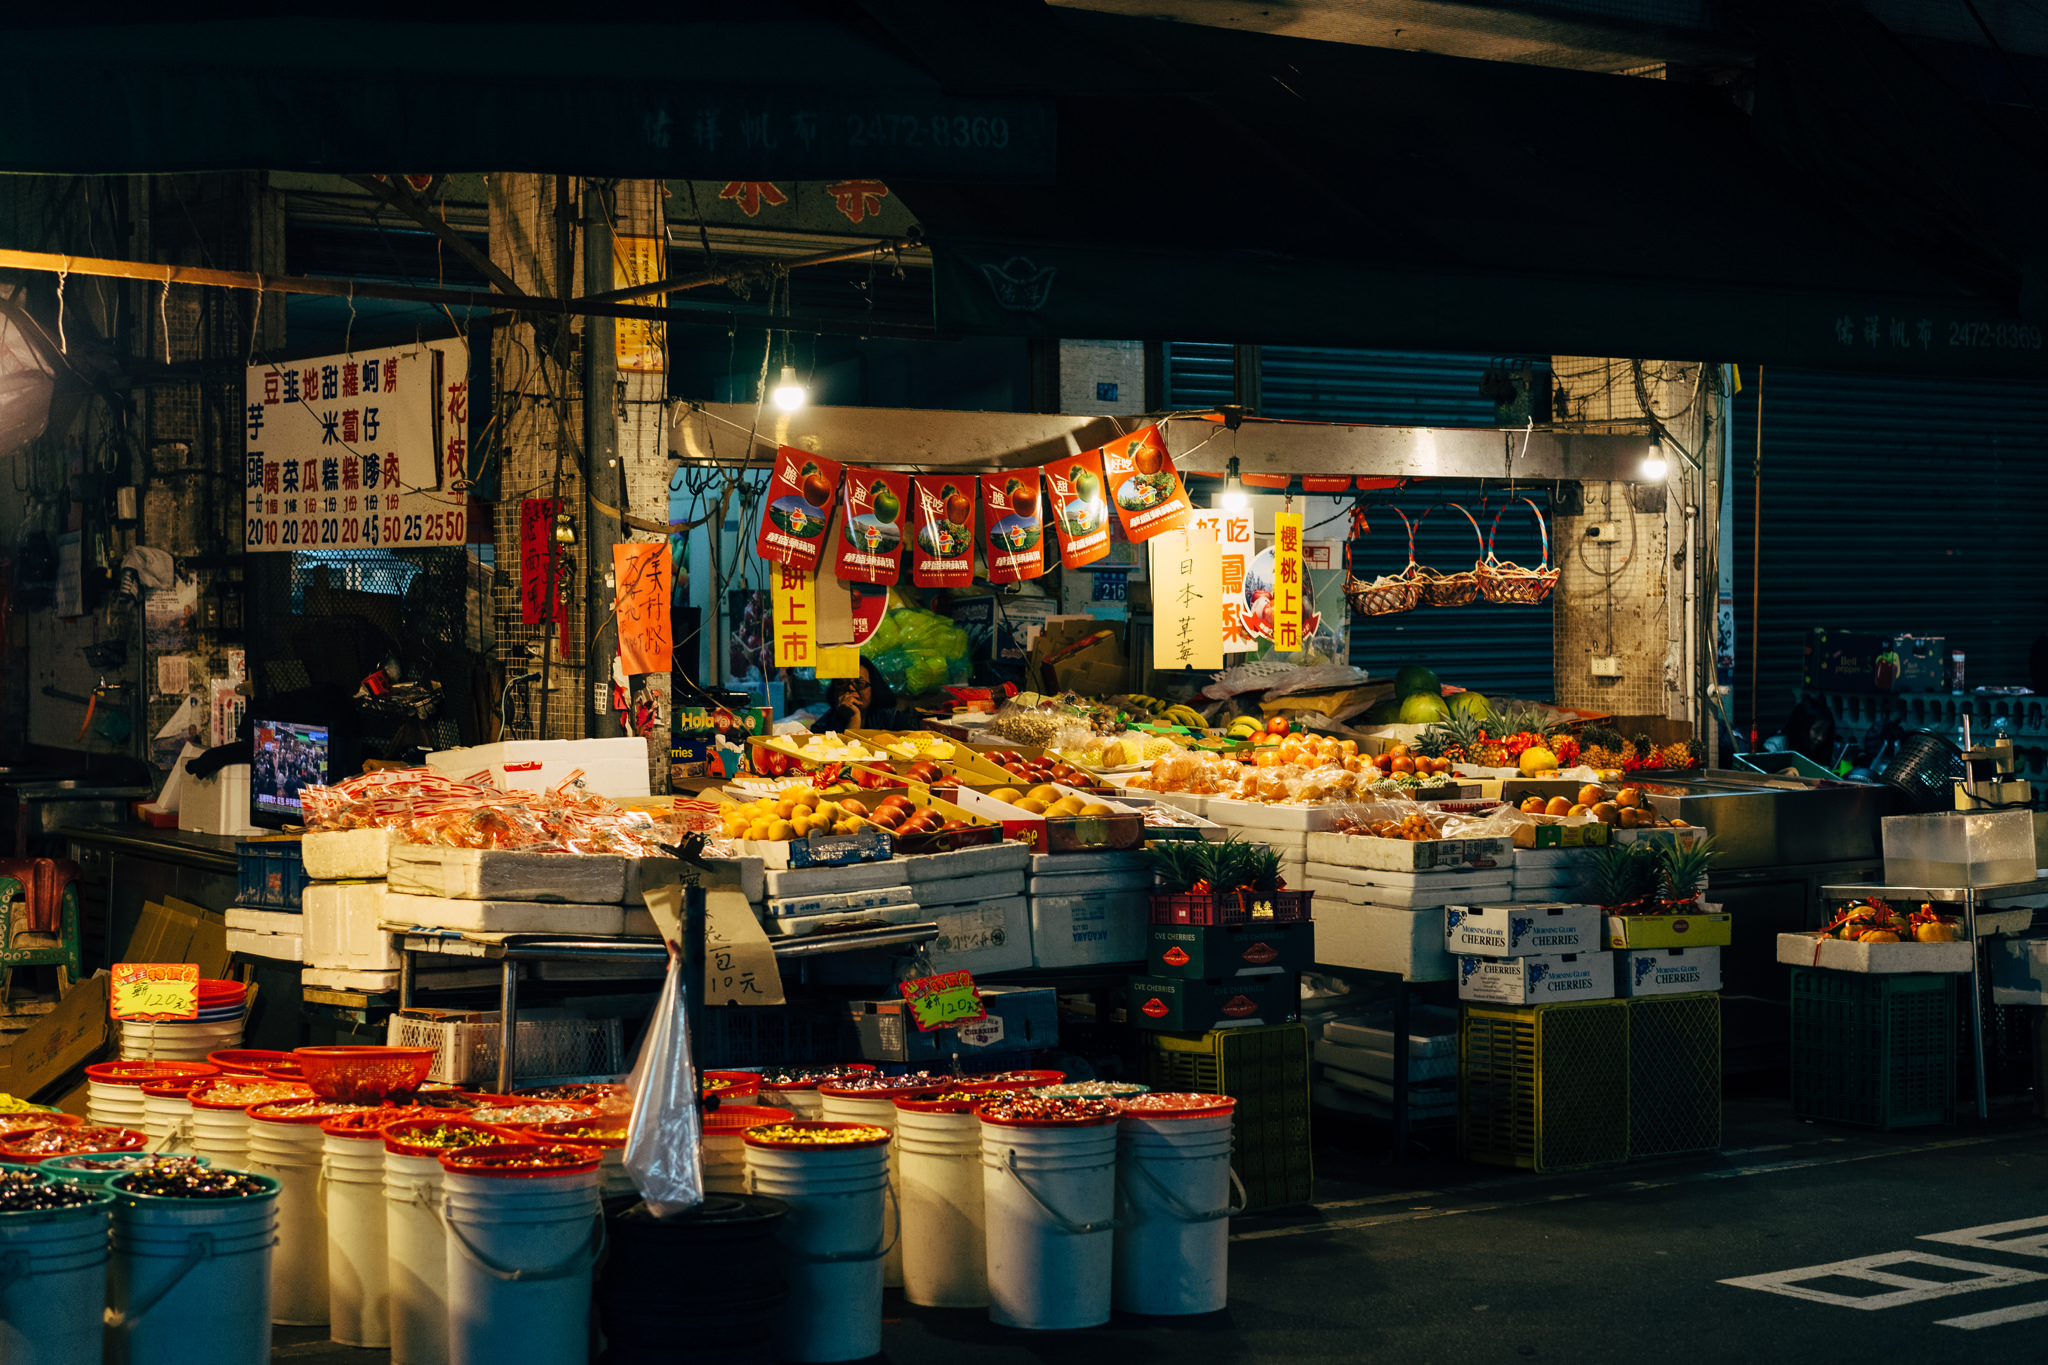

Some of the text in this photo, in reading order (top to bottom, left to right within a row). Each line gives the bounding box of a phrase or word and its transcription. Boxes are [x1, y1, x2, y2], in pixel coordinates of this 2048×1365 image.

[849, 114, 1009, 149] 2472-8369
[1949, 321, 2042, 349] 2472-8369
[264, 371, 280, 494] 豆腐
[283, 369, 299, 494] 韭菜
[302, 368, 319, 493] 地瓜
[322, 365, 339, 491] 甜米糕
[447, 381, 467, 478] 花枝
[247, 403, 264, 489] 芋頭
[1110, 458, 1134, 471] 好吃
[855, 488, 867, 502] 甜
[1056, 480, 1069, 493] 甜
[248, 518, 264, 545] 20
[264, 520, 277, 544] 10
[282, 519, 298, 544] 20
[302, 518, 318, 544] 20
[322, 518, 338, 543] 20
[342, 518, 358, 543] 20
[362, 515, 379, 546] 45
[383, 516, 400, 542] 50
[404, 515, 422, 541] 25
[425, 514, 444, 541] 25
[446, 511, 464, 541] 50
[1102, 583, 1125, 600] 216
[1280, 525, 1298, 648] 櫻桃上市
[1176, 558, 1203, 661] 日本草莓
[682, 712, 714, 728] Hola
[1167, 933, 1196, 942] CHERRIES
[1461, 934, 1506, 947] CHERRIES
[1462, 925, 1503, 936] MORNING GLORY
[1532, 935, 1579, 946] CHERRIES
[1533, 926, 1576, 935] MORNING GLORY
[1484, 965, 1521, 975] CHERRIES
[1572, 970, 1591, 978] GLORY
[1655, 965, 1698, 974] MORNING GLORY
[1655, 972, 1700, 984] CHERRIES
[712, 973, 763, 993] 10元
[1147, 984, 1175, 994] CHERRIES
[1548, 979, 1592, 992] CHERRIES
